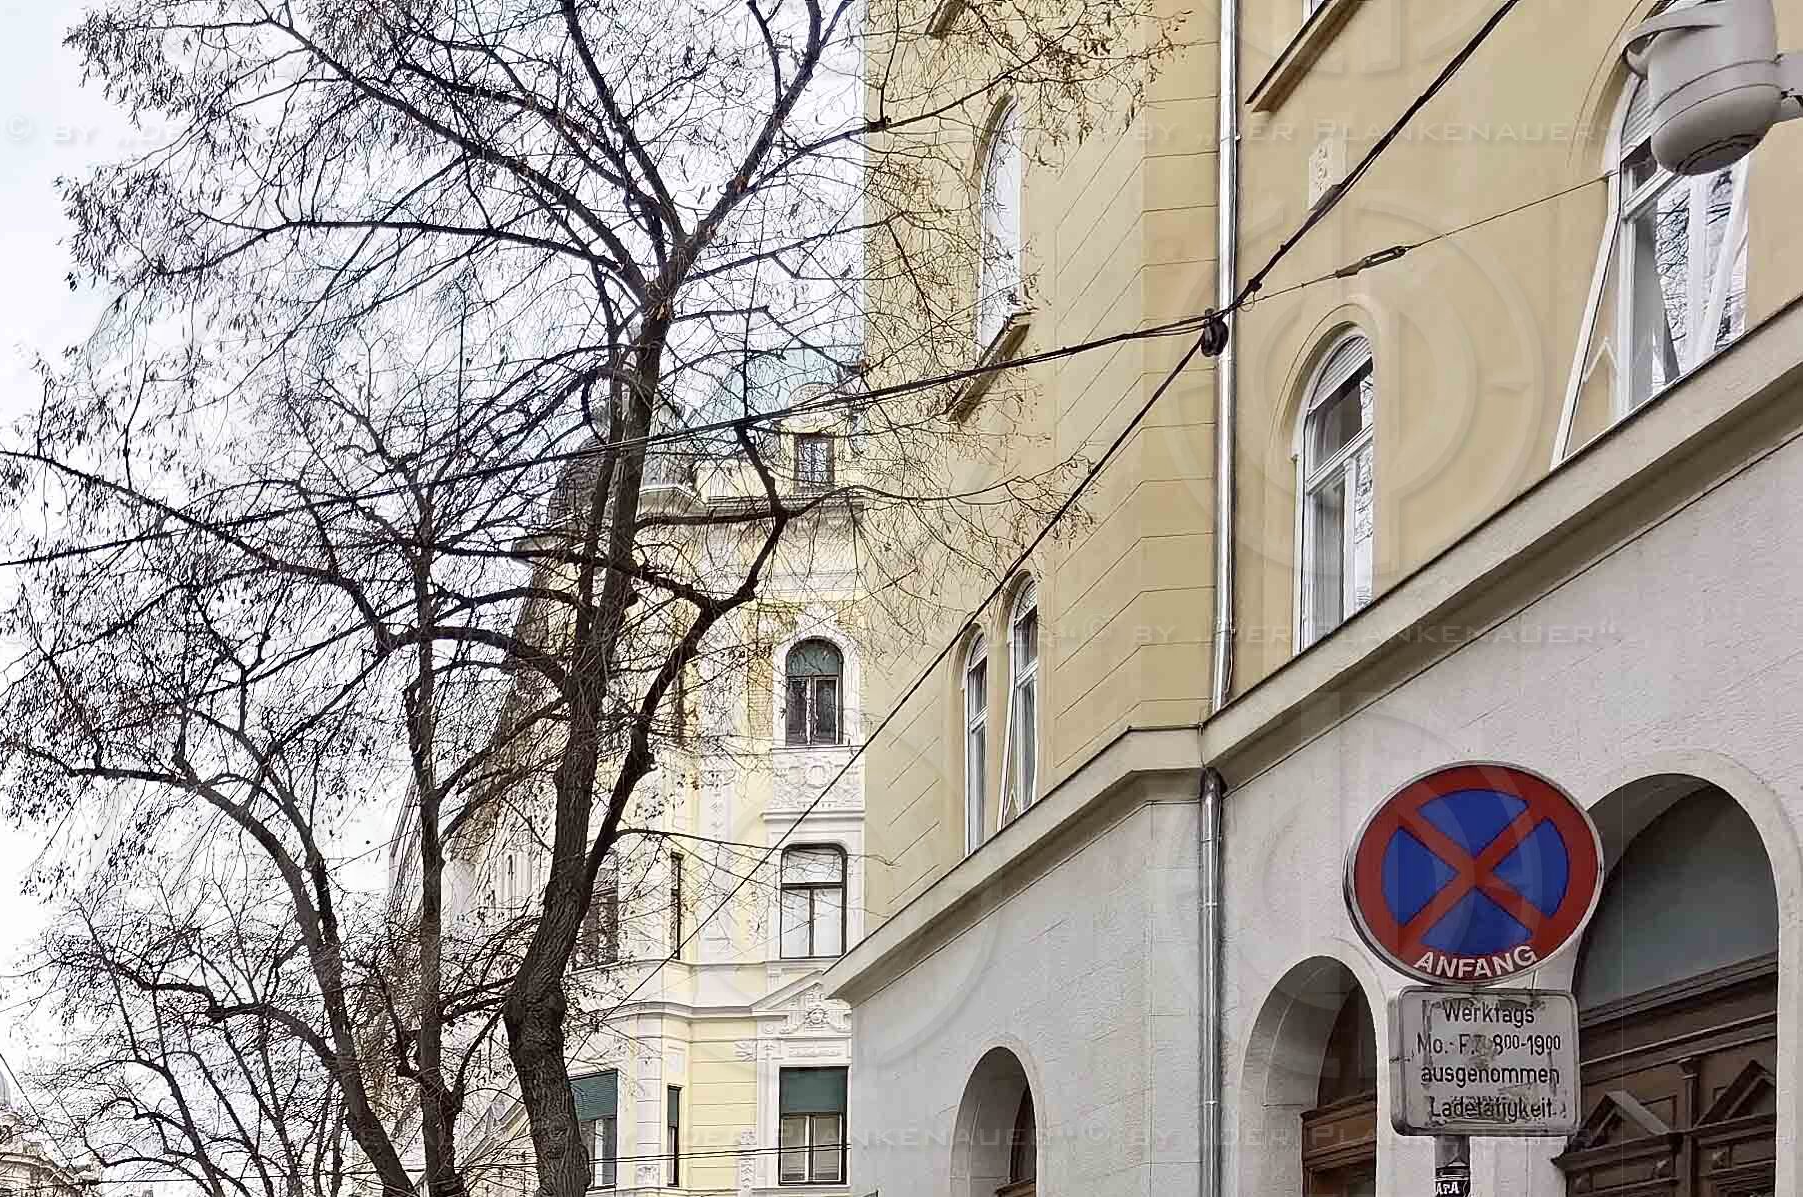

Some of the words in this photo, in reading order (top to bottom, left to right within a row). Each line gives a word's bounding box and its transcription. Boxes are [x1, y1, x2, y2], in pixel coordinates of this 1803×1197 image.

[1414, 945, 1538, 978] ANFANG
[1444, 1002, 1535, 1028] Werktags
[1421, 1064, 1560, 1088] ausgenommen
